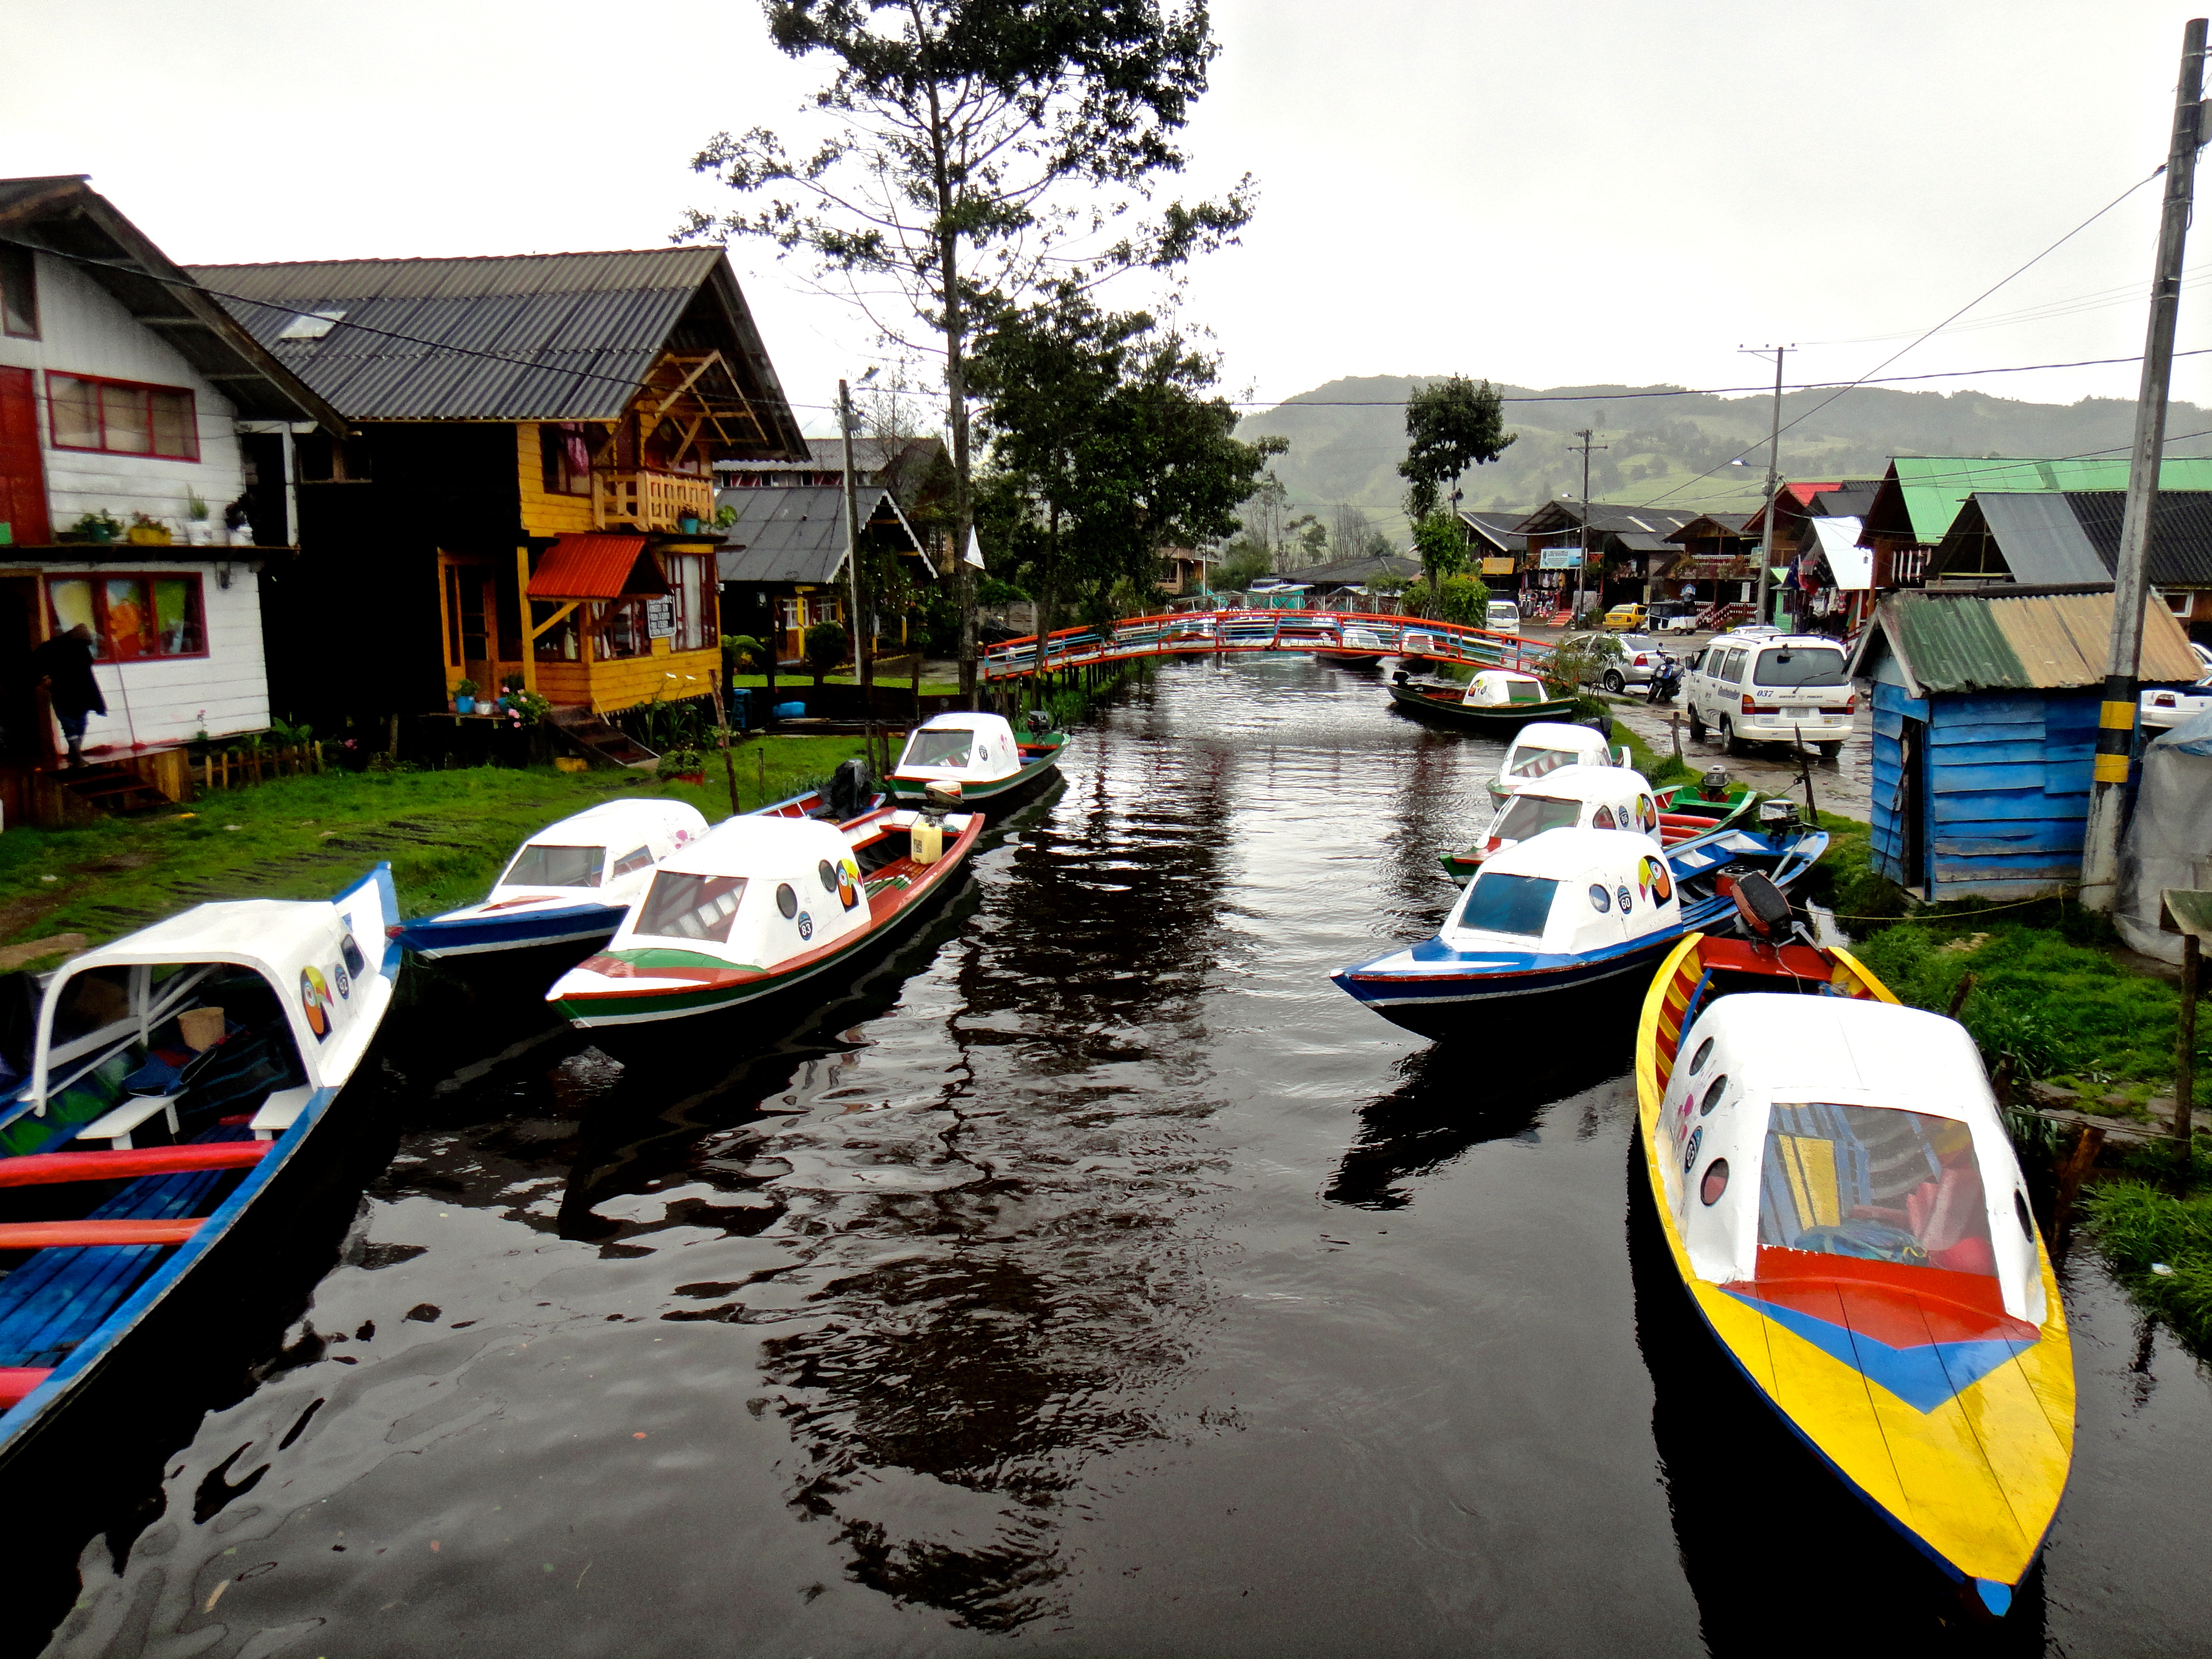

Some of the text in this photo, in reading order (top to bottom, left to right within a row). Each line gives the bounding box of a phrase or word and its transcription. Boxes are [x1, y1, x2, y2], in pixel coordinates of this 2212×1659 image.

[1621, 815, 1628, 824] 96
[1621, 897, 1630, 909] 60
[802, 923, 811, 936] 83
[339, 979, 348, 994] 92
